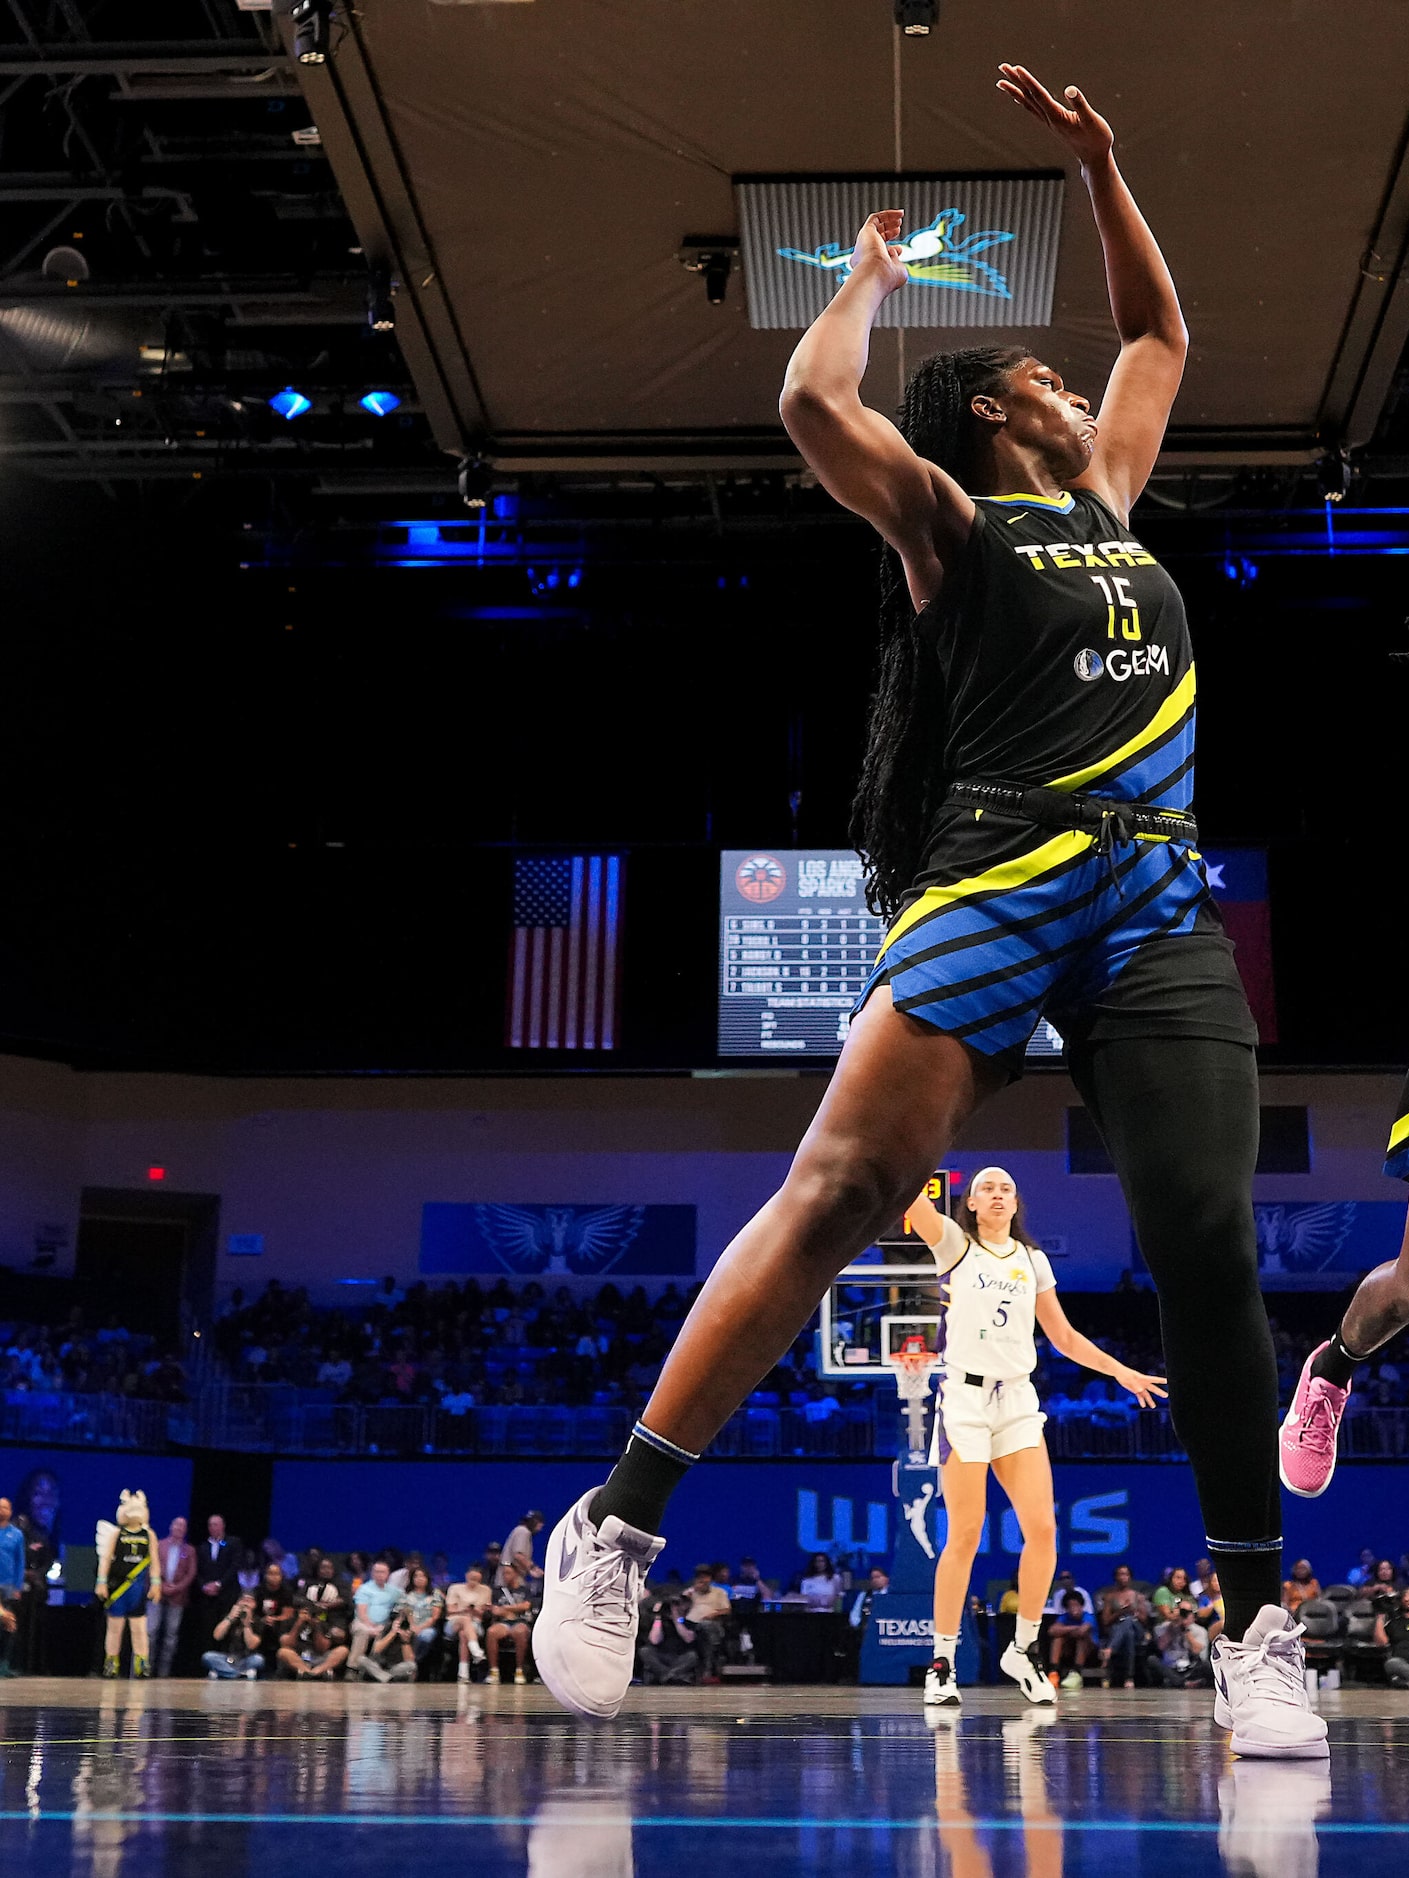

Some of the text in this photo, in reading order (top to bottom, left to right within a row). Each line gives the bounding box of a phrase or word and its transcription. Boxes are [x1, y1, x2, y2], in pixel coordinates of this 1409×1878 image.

[1014, 541, 1158, 571] TEXAS
[1090, 575, 1142, 641] 15
[798, 860, 826, 878] LOS
[798, 878, 857, 897] SPARKS
[993, 1300, 1012, 1328] 5
